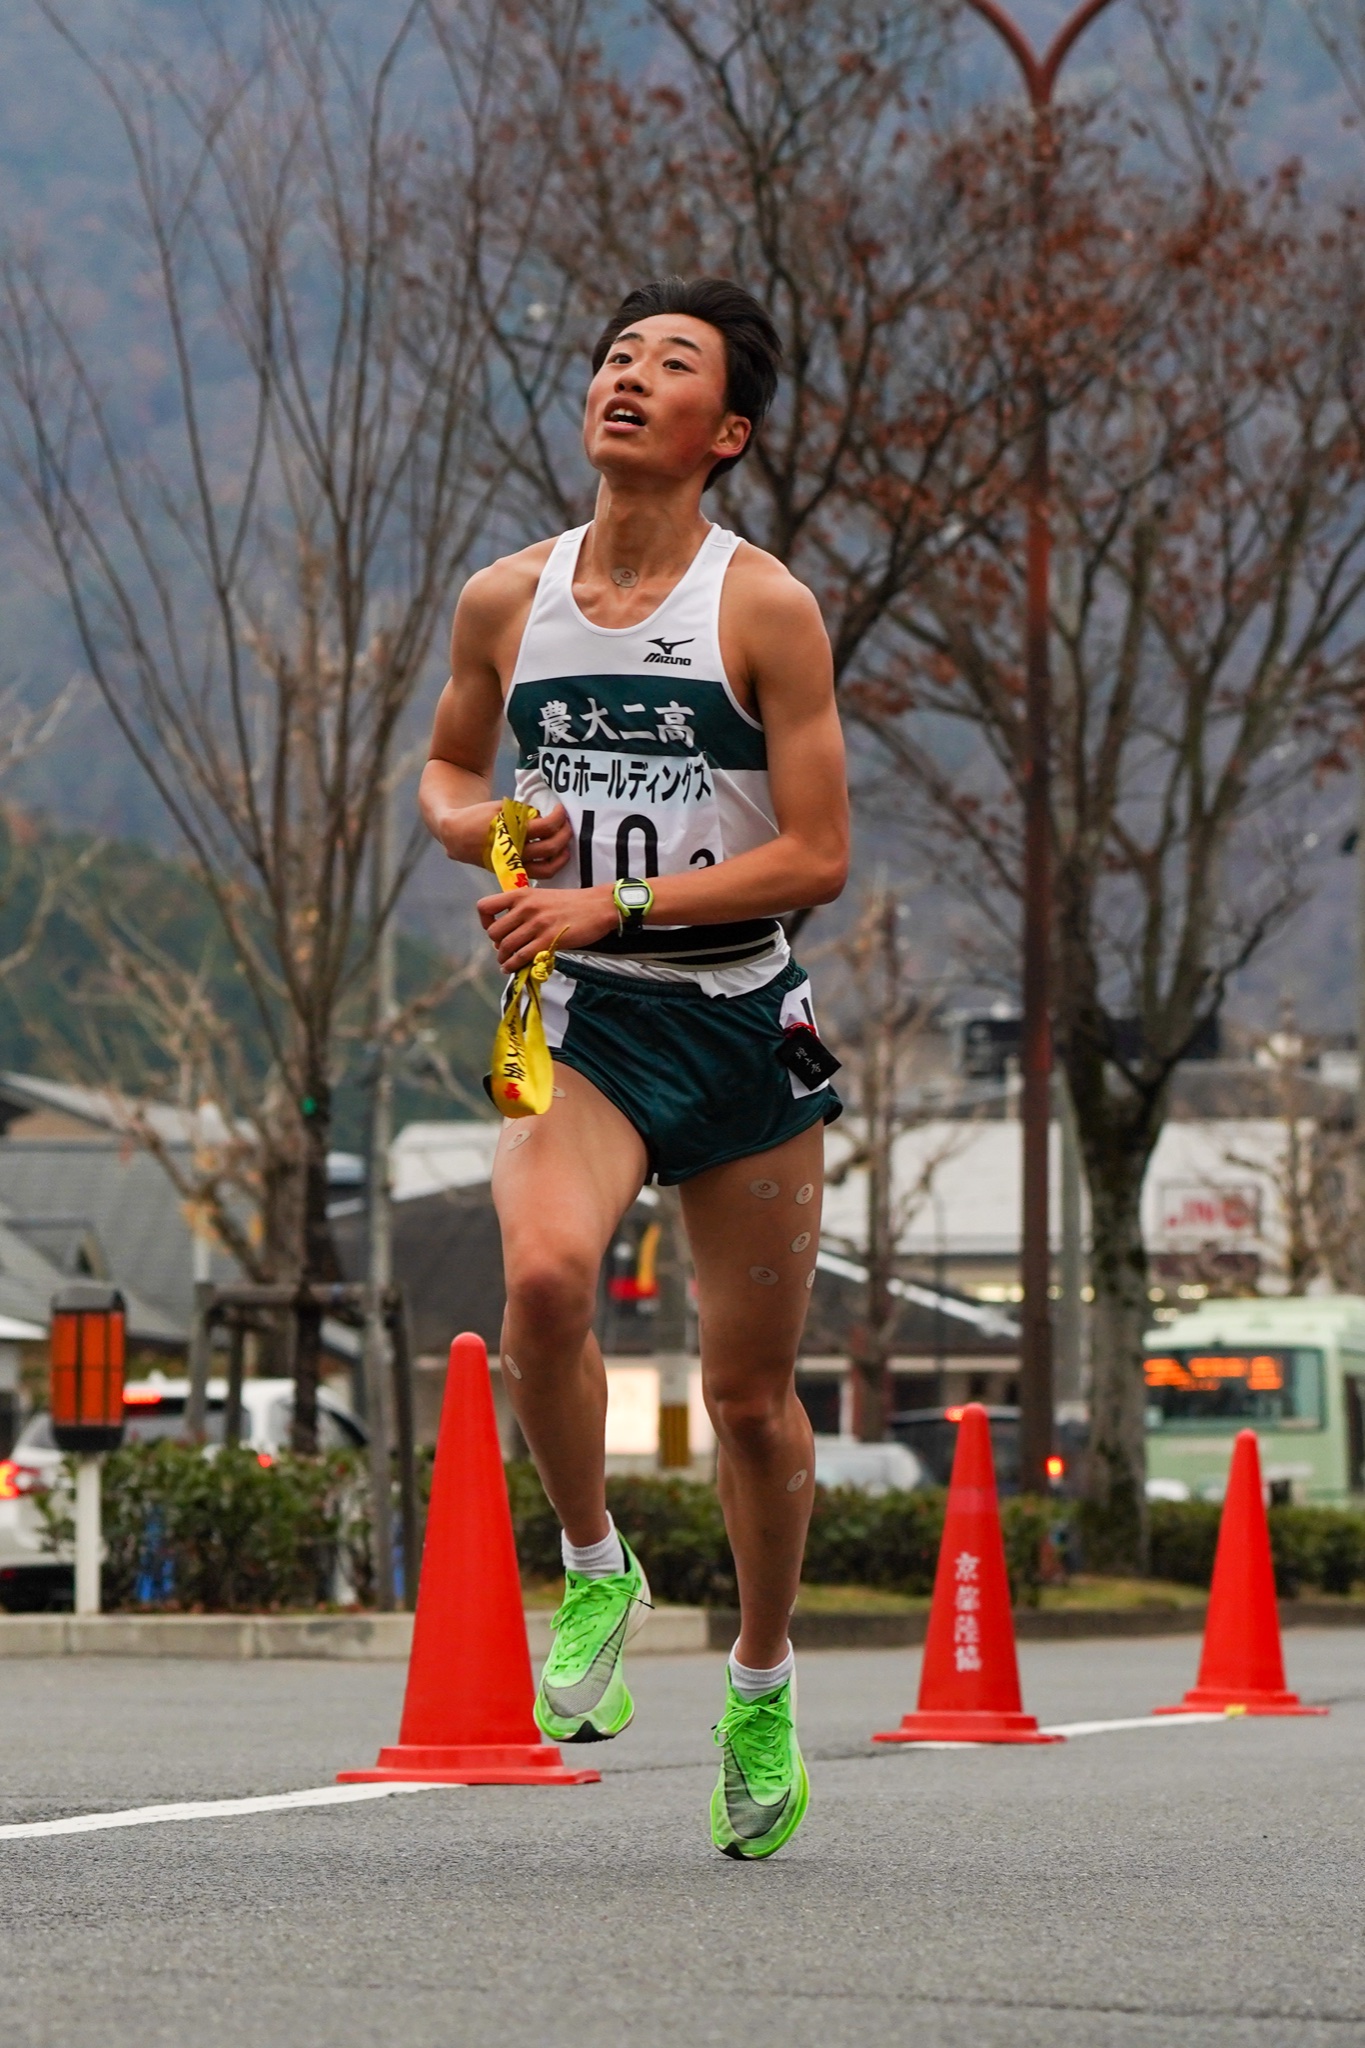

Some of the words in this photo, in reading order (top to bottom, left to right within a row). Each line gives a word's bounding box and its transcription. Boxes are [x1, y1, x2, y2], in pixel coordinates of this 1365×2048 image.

[538, 697, 695, 748] 農大二高
[541, 751, 711, 803] SGホールディングス
